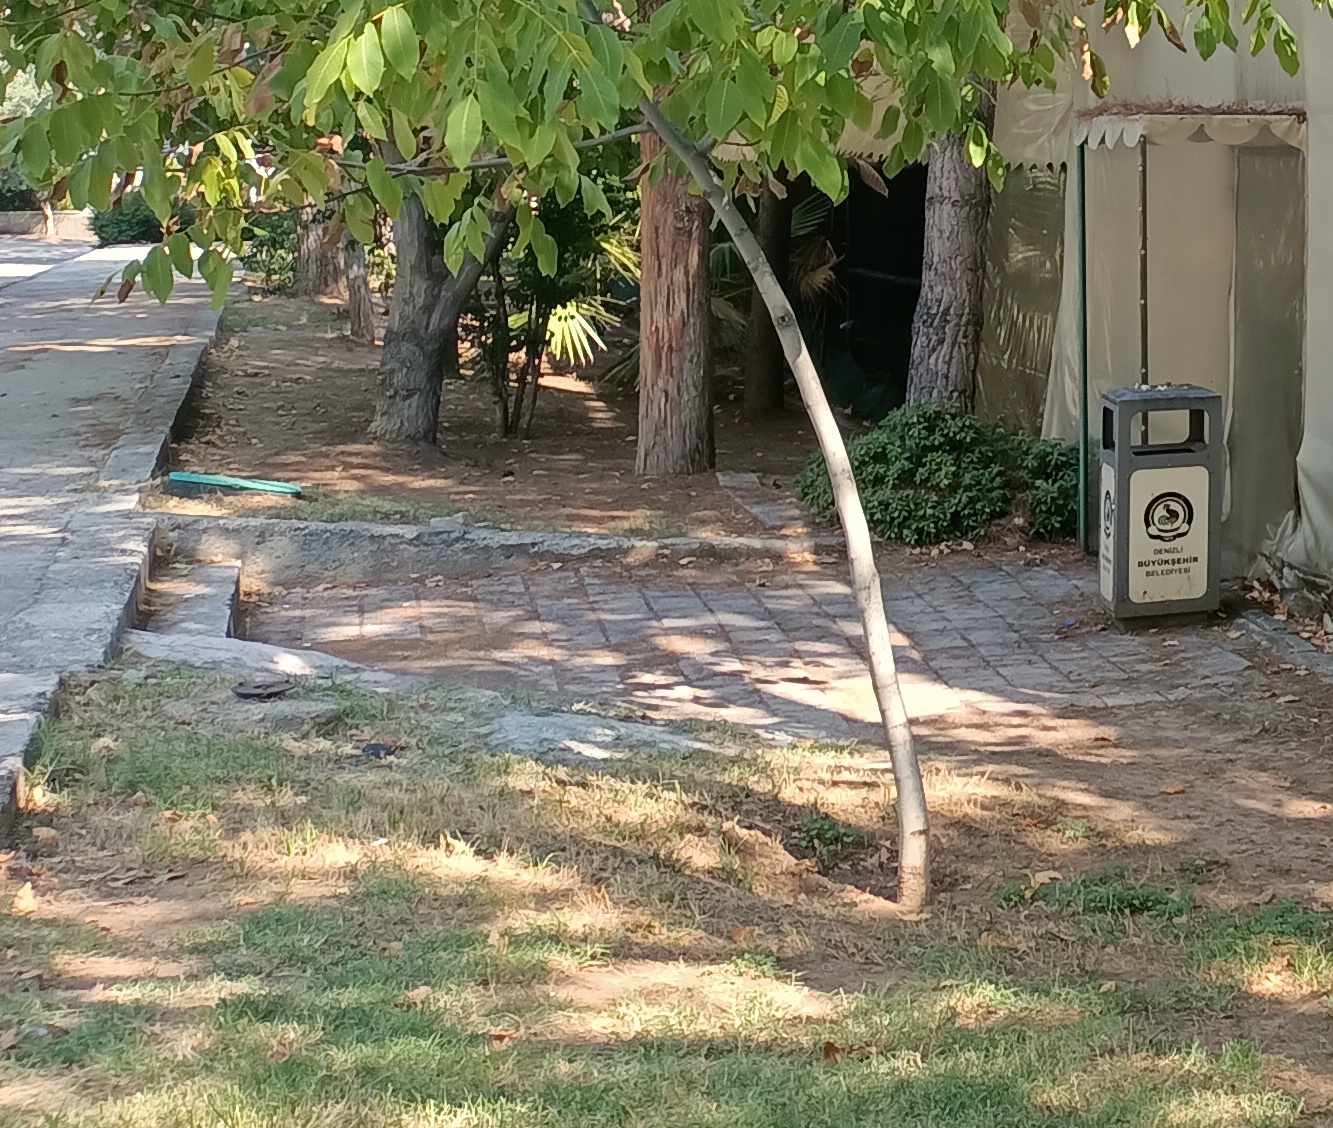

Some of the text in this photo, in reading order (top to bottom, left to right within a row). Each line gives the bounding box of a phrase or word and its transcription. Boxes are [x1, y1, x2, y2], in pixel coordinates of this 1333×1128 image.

[1153, 546, 1183, 555] DENİZLİ
[1137, 555, 1199, 567] BÜYÜKŞEHİR
[1145, 566, 1191, 577] BELEDİYESİ
